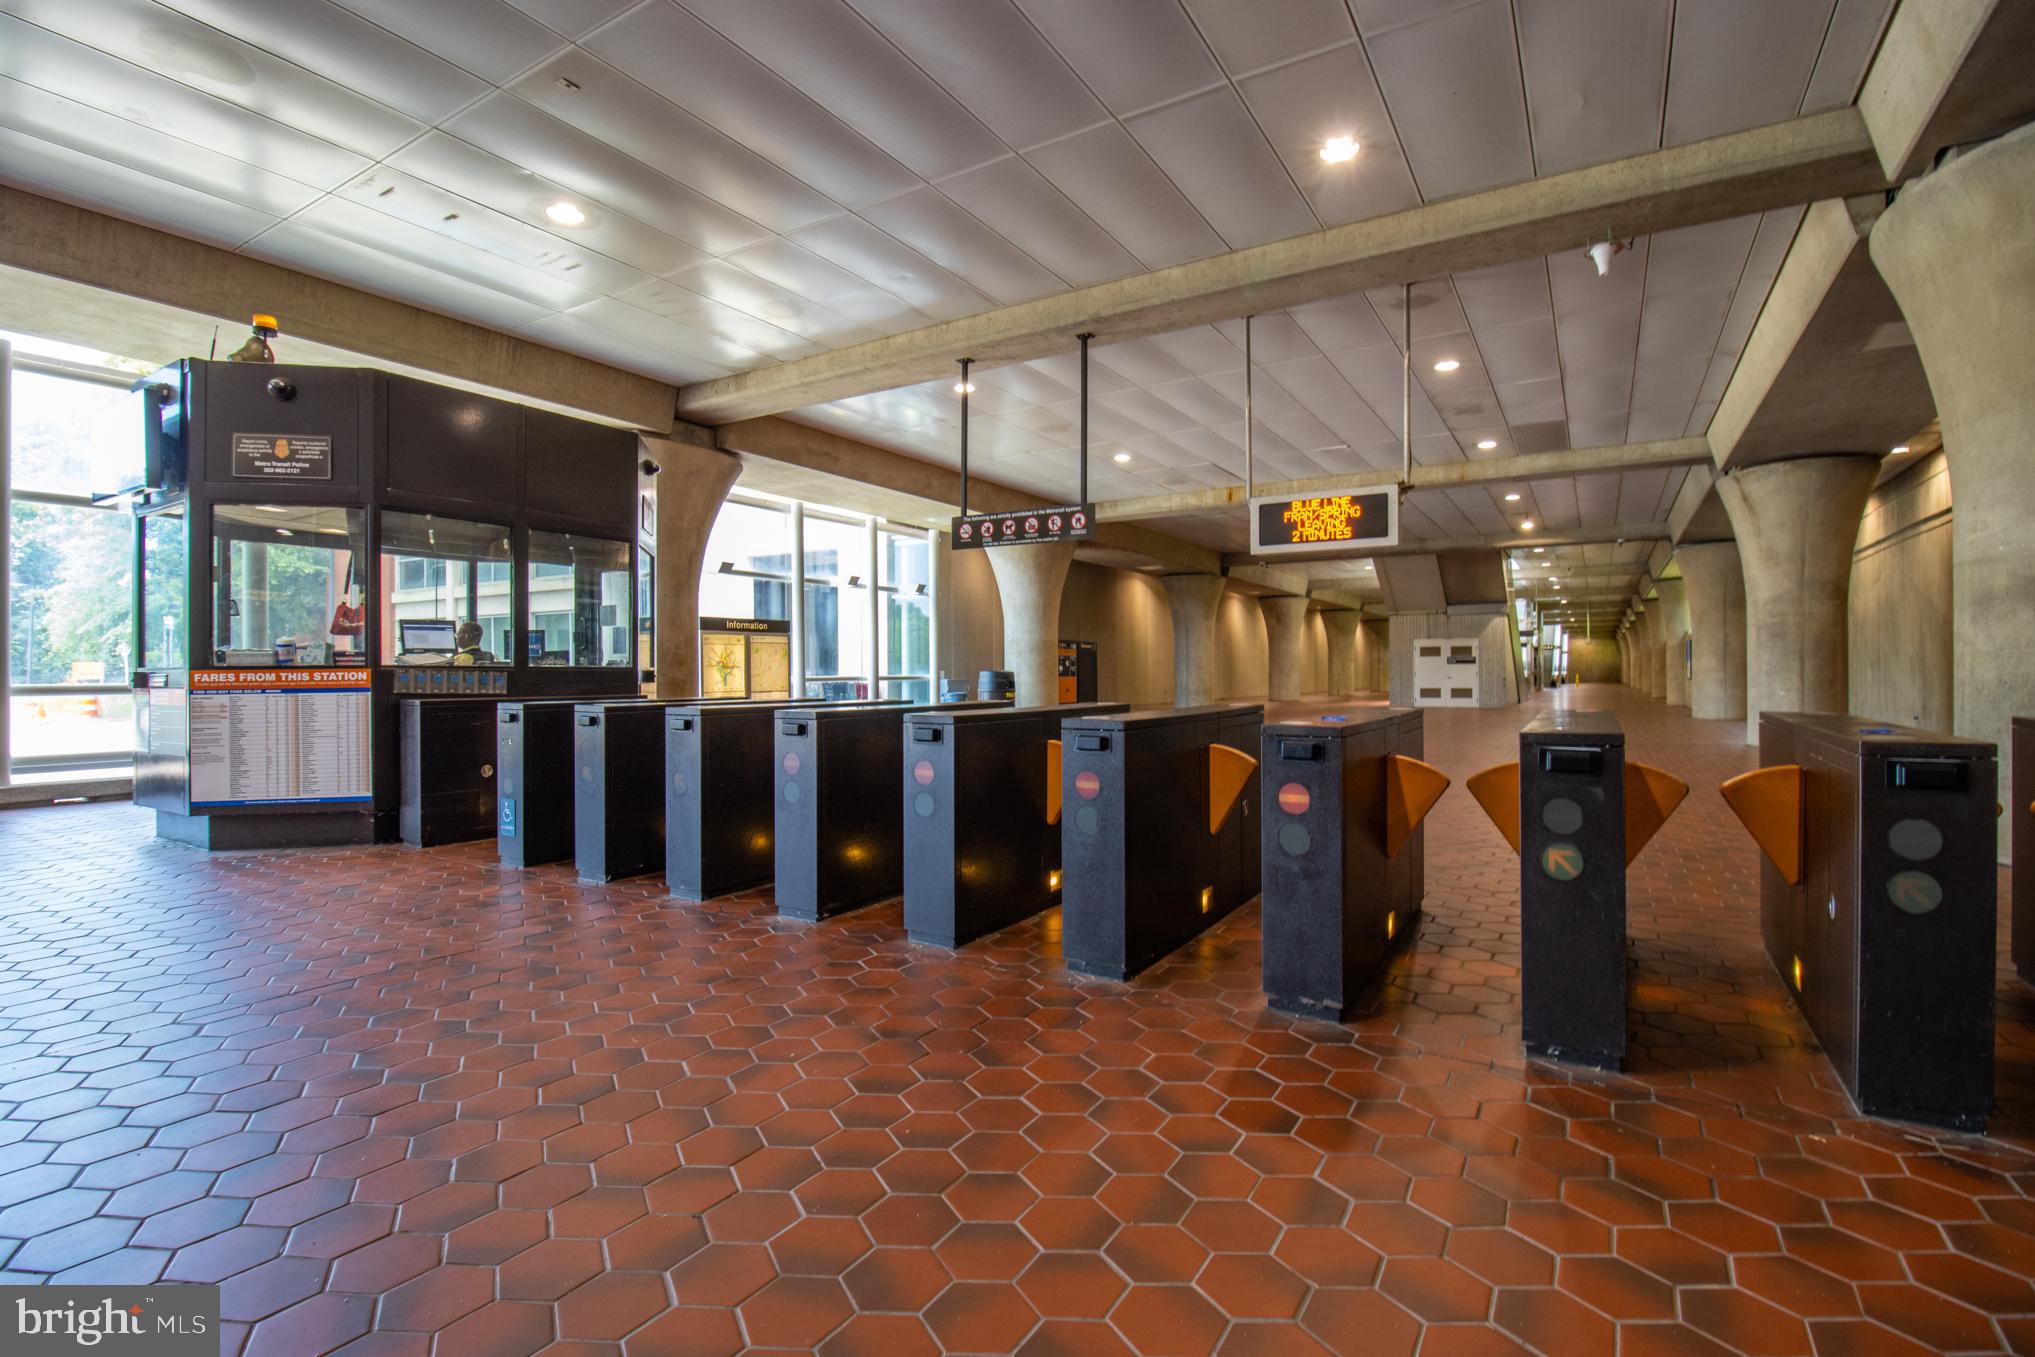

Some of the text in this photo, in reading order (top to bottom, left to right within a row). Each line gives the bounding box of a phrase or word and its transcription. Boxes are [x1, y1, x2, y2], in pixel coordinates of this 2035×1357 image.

[1291, 496, 1352, 512] BLUE LINE
[1283, 506, 1361, 523] FRAN/SPRING
[1297, 518, 1346, 531] LEAVING
[1292, 527, 1352, 542] 2 MINUTES
[726, 620, 768, 629] Information
[194, 671, 367, 682] FARES FROM THIS STATION
